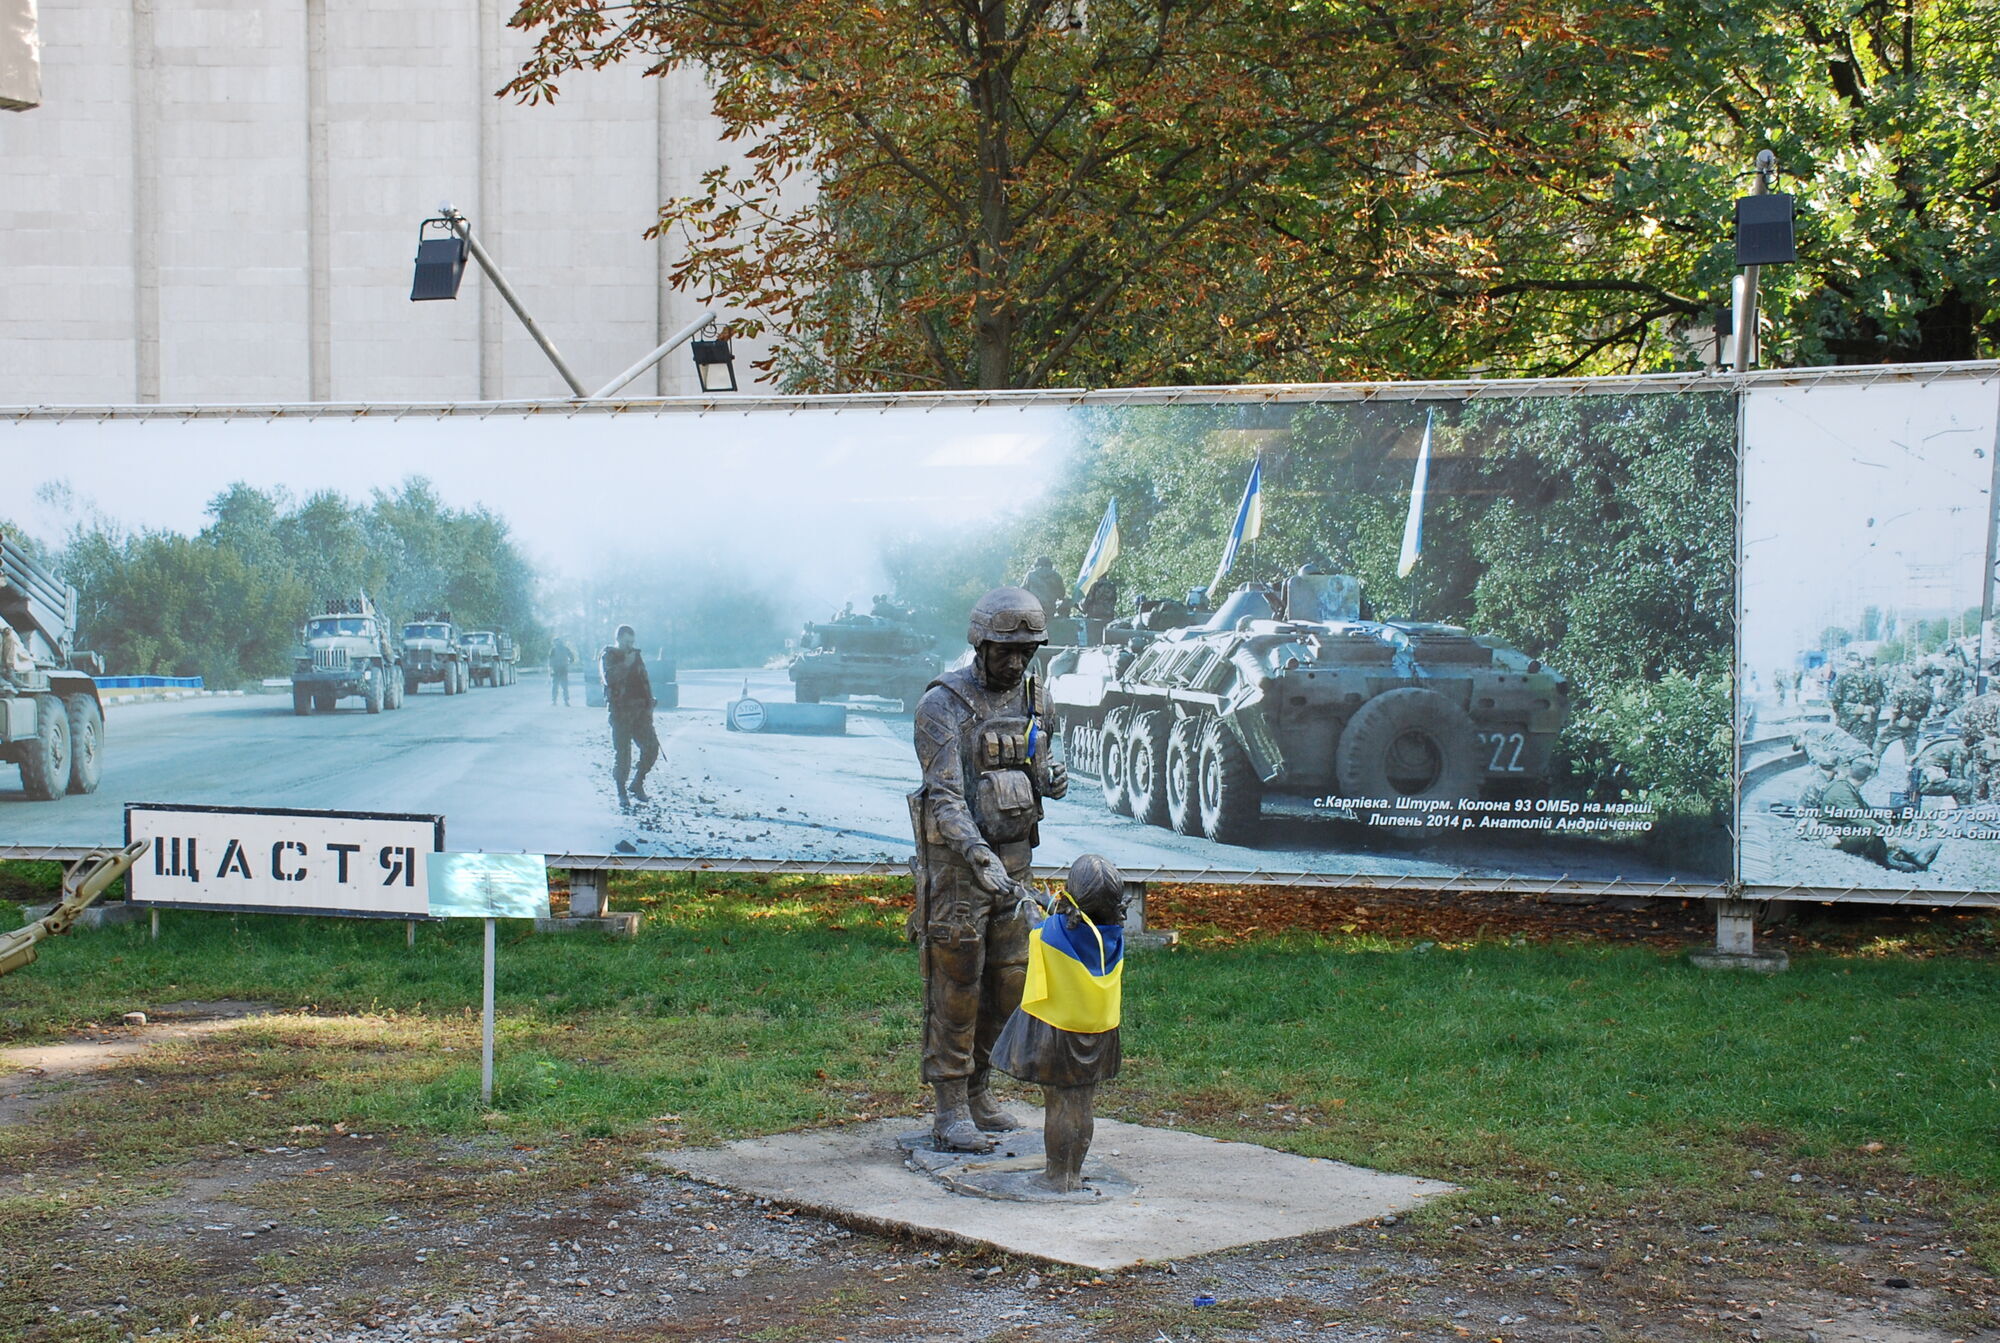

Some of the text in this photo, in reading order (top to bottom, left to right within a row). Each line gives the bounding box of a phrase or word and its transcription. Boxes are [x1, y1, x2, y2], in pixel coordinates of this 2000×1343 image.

[1313, 796, 1655, 816] с.Карлівка. Штурм. Колона 93 ОМБр на марші.
[1902, 806, 1948, 820] Вихід
[1952, 811, 1964, 824] у
[1368, 813, 1652, 832] Липень 2014 р. Анатолій Андрійченко
[1809, 824, 1872, 838] травня
[1876, 824, 1914, 838] 2014
[1917, 828, 1931, 841] р.
[1937, 827, 1961, 839] 2-й
[154, 836, 416, 888] ЩАСТЯ
